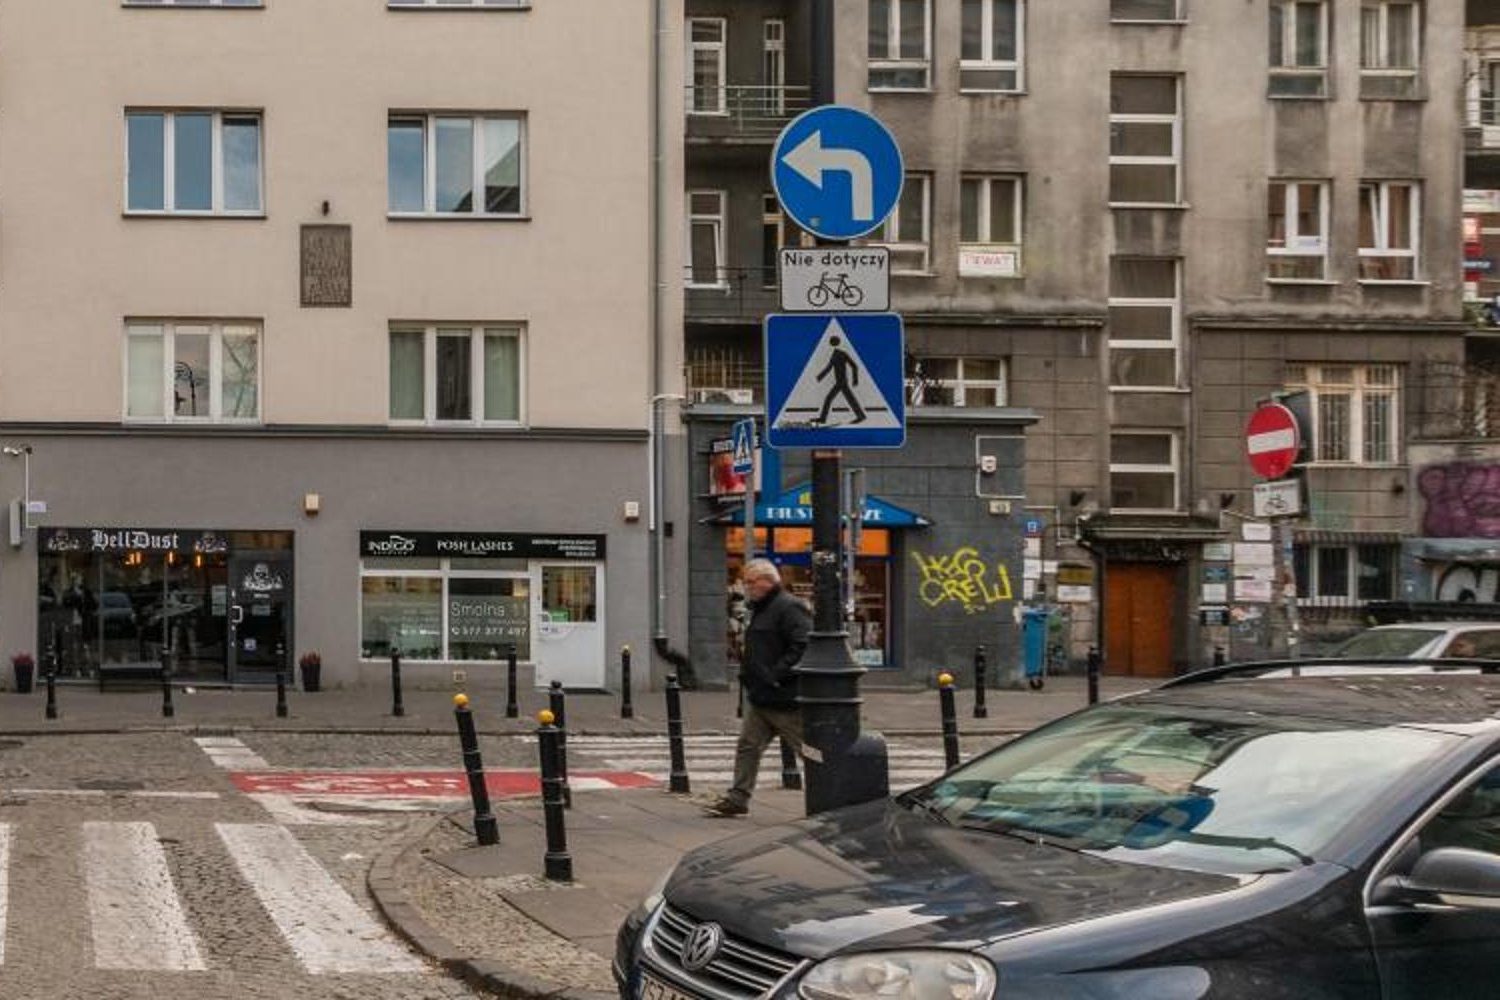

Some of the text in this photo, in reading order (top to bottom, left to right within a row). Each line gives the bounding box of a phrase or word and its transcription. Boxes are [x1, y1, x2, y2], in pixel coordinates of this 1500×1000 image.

[785, 252, 885, 270] Nie dotyczy
[91, 529, 179, 551] HellDust
[437, 540, 514, 551] POSH LASHES
[451, 601, 505, 617] Smolna
